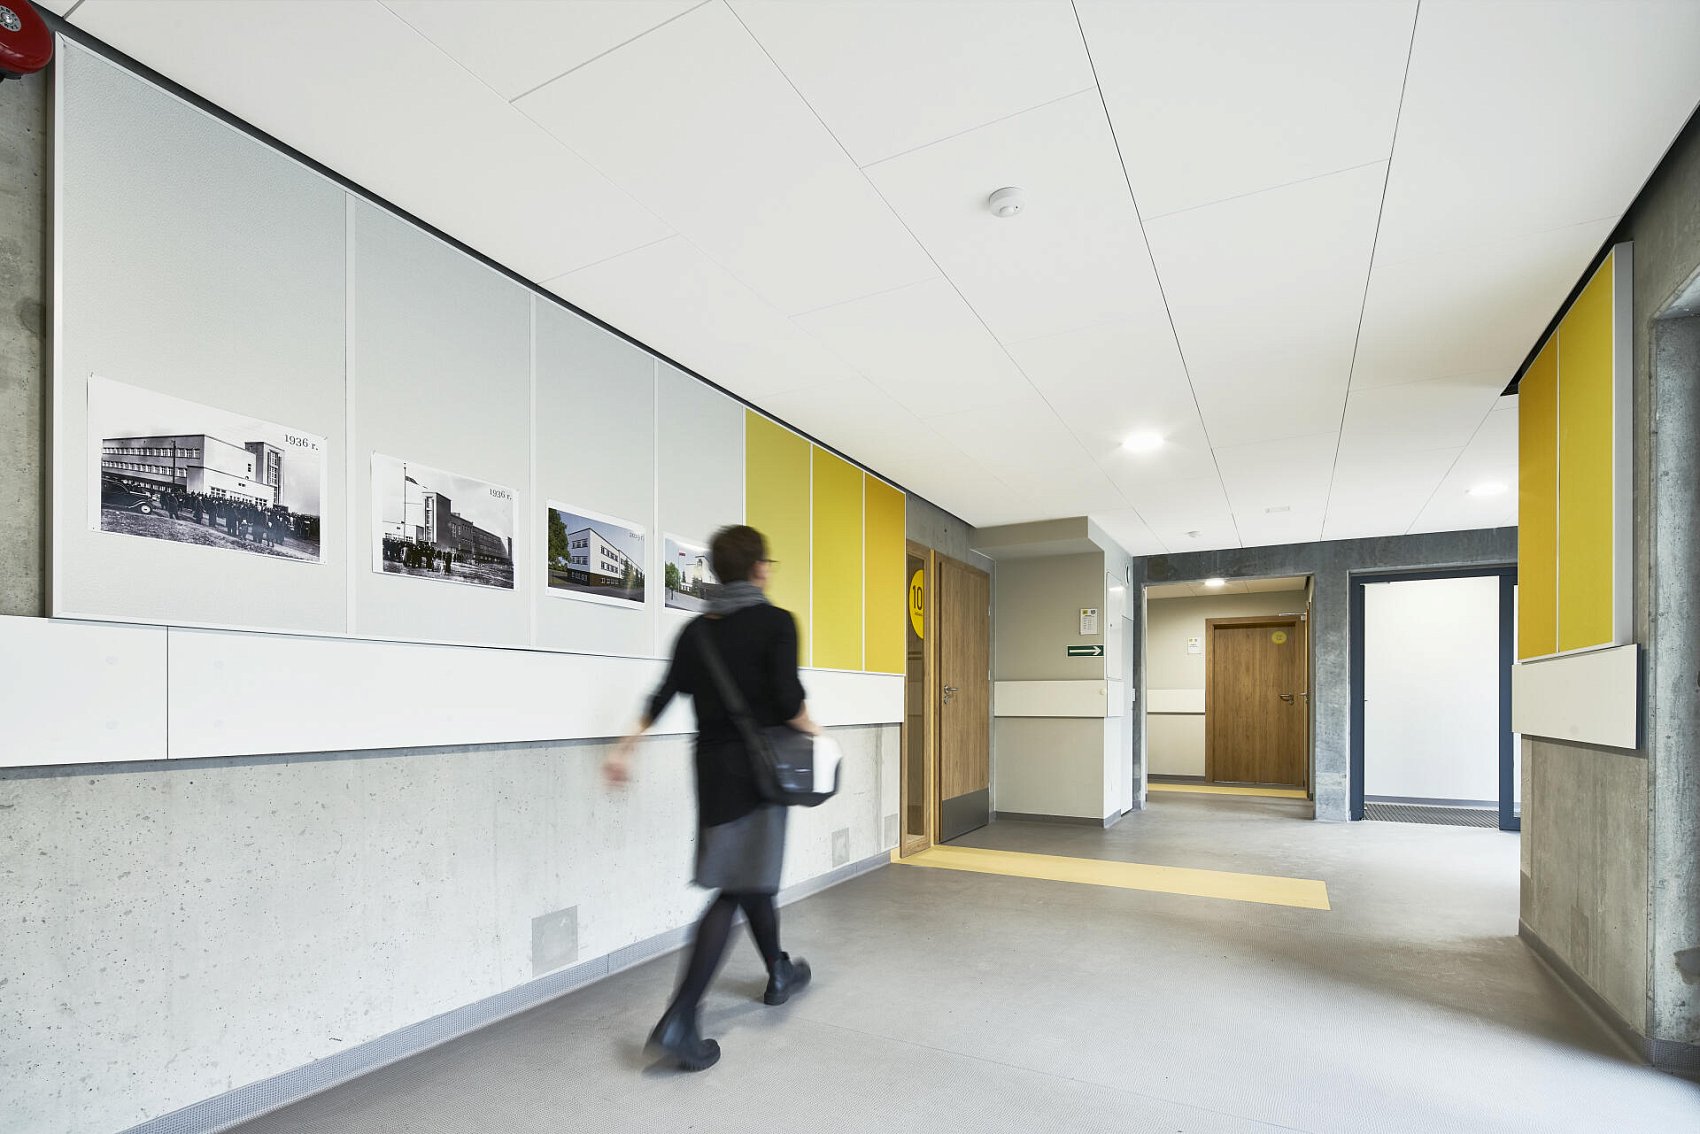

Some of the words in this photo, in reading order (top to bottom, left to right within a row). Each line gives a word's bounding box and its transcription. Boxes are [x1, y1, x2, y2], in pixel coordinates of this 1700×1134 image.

[285, 434, 308, 447] 1936
[311, 443, 319, 451] r.
[489, 488, 506, 498] 1936
[913, 585, 923, 610] 10
